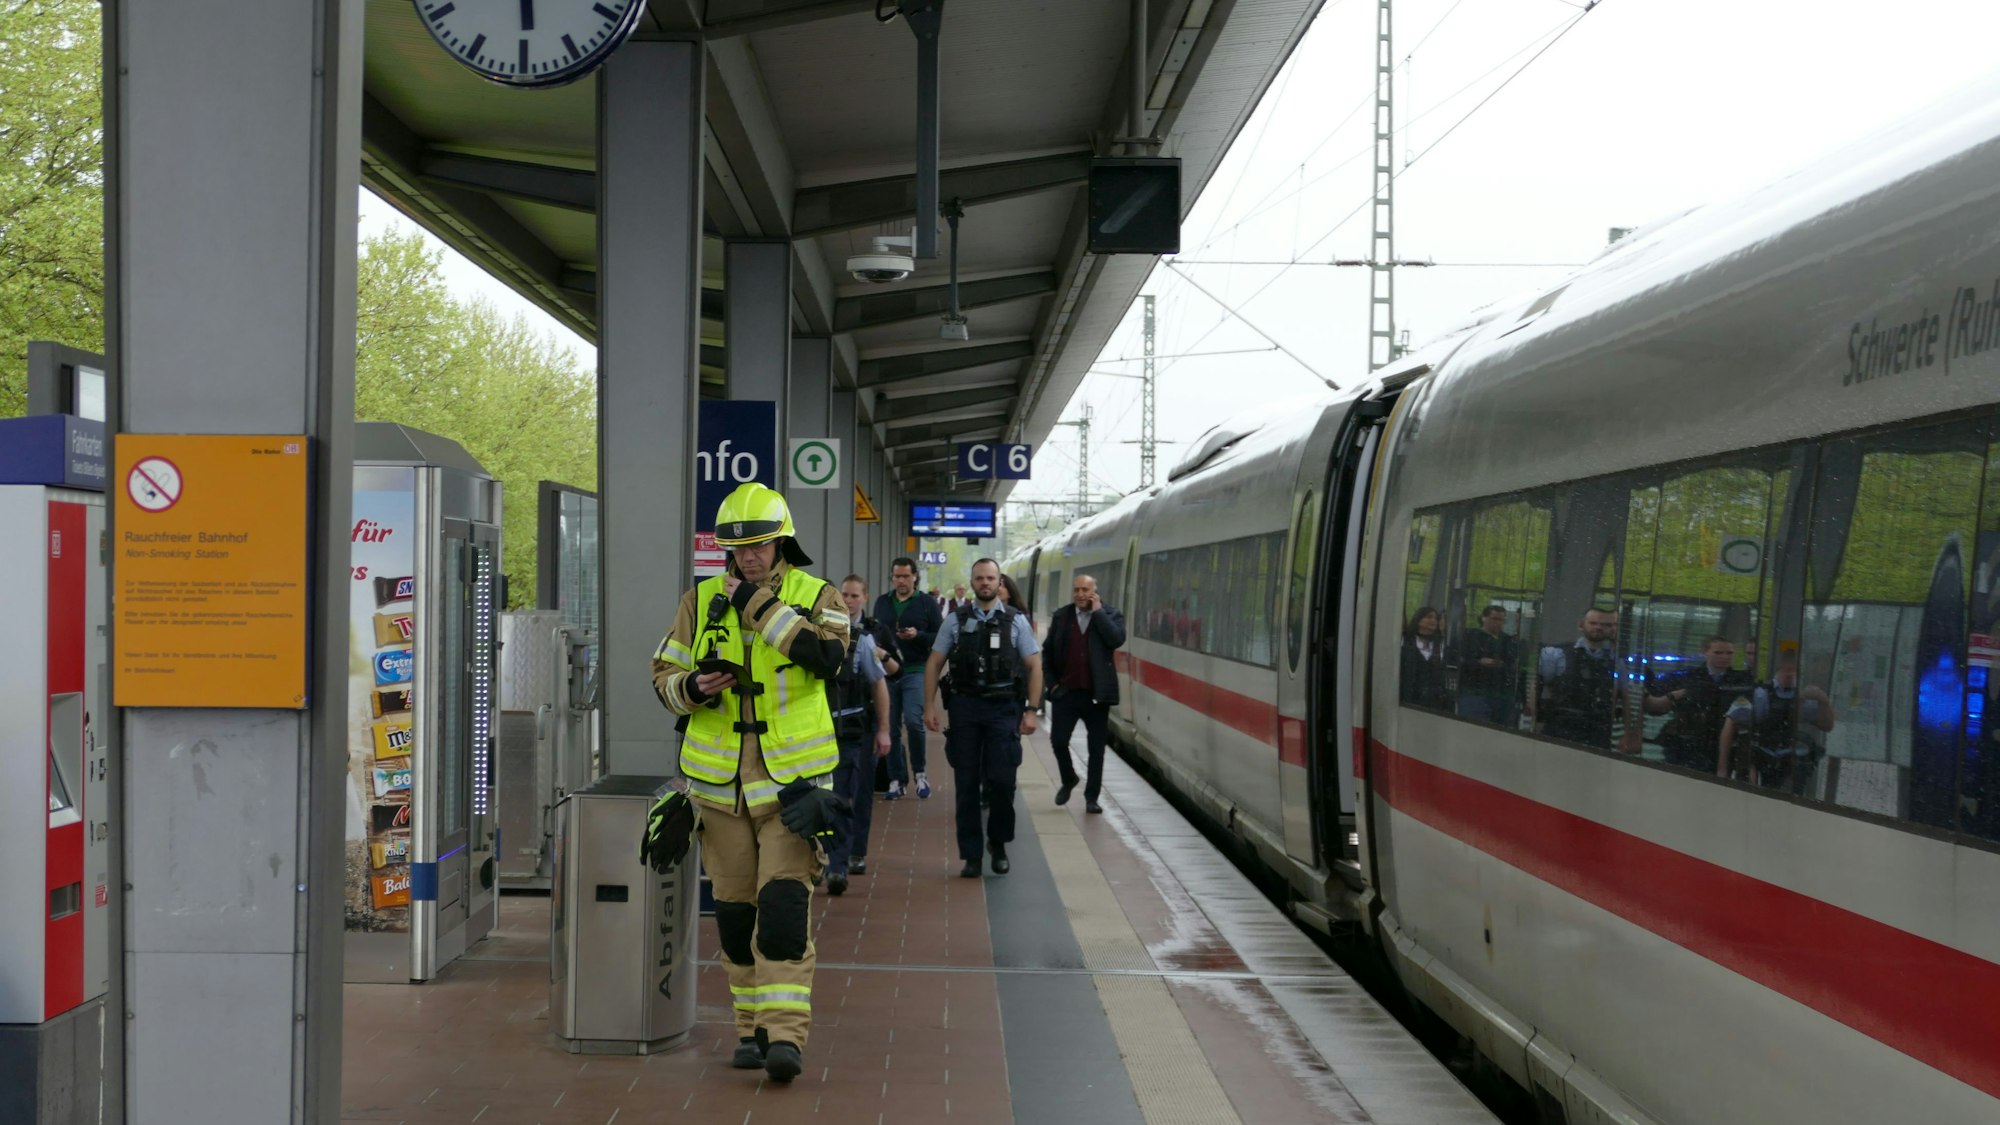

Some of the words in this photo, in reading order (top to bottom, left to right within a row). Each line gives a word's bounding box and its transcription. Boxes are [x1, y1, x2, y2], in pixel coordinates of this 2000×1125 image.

[1843, 307, 1940, 387] Schwerte
[696, 439, 759, 482] nfo
[967, 443, 990, 472] C
[1008, 445, 1028, 473] 6
[124, 531, 192, 543] Rauchfreier
[198, 532, 249, 544] Bahnhof
[351, 518, 393, 543] für
[125, 549, 192, 560] Non-Smoking
[195, 549, 230, 559] Station
[924, 552, 934, 563] A
[938, 552, 947, 562] 6
